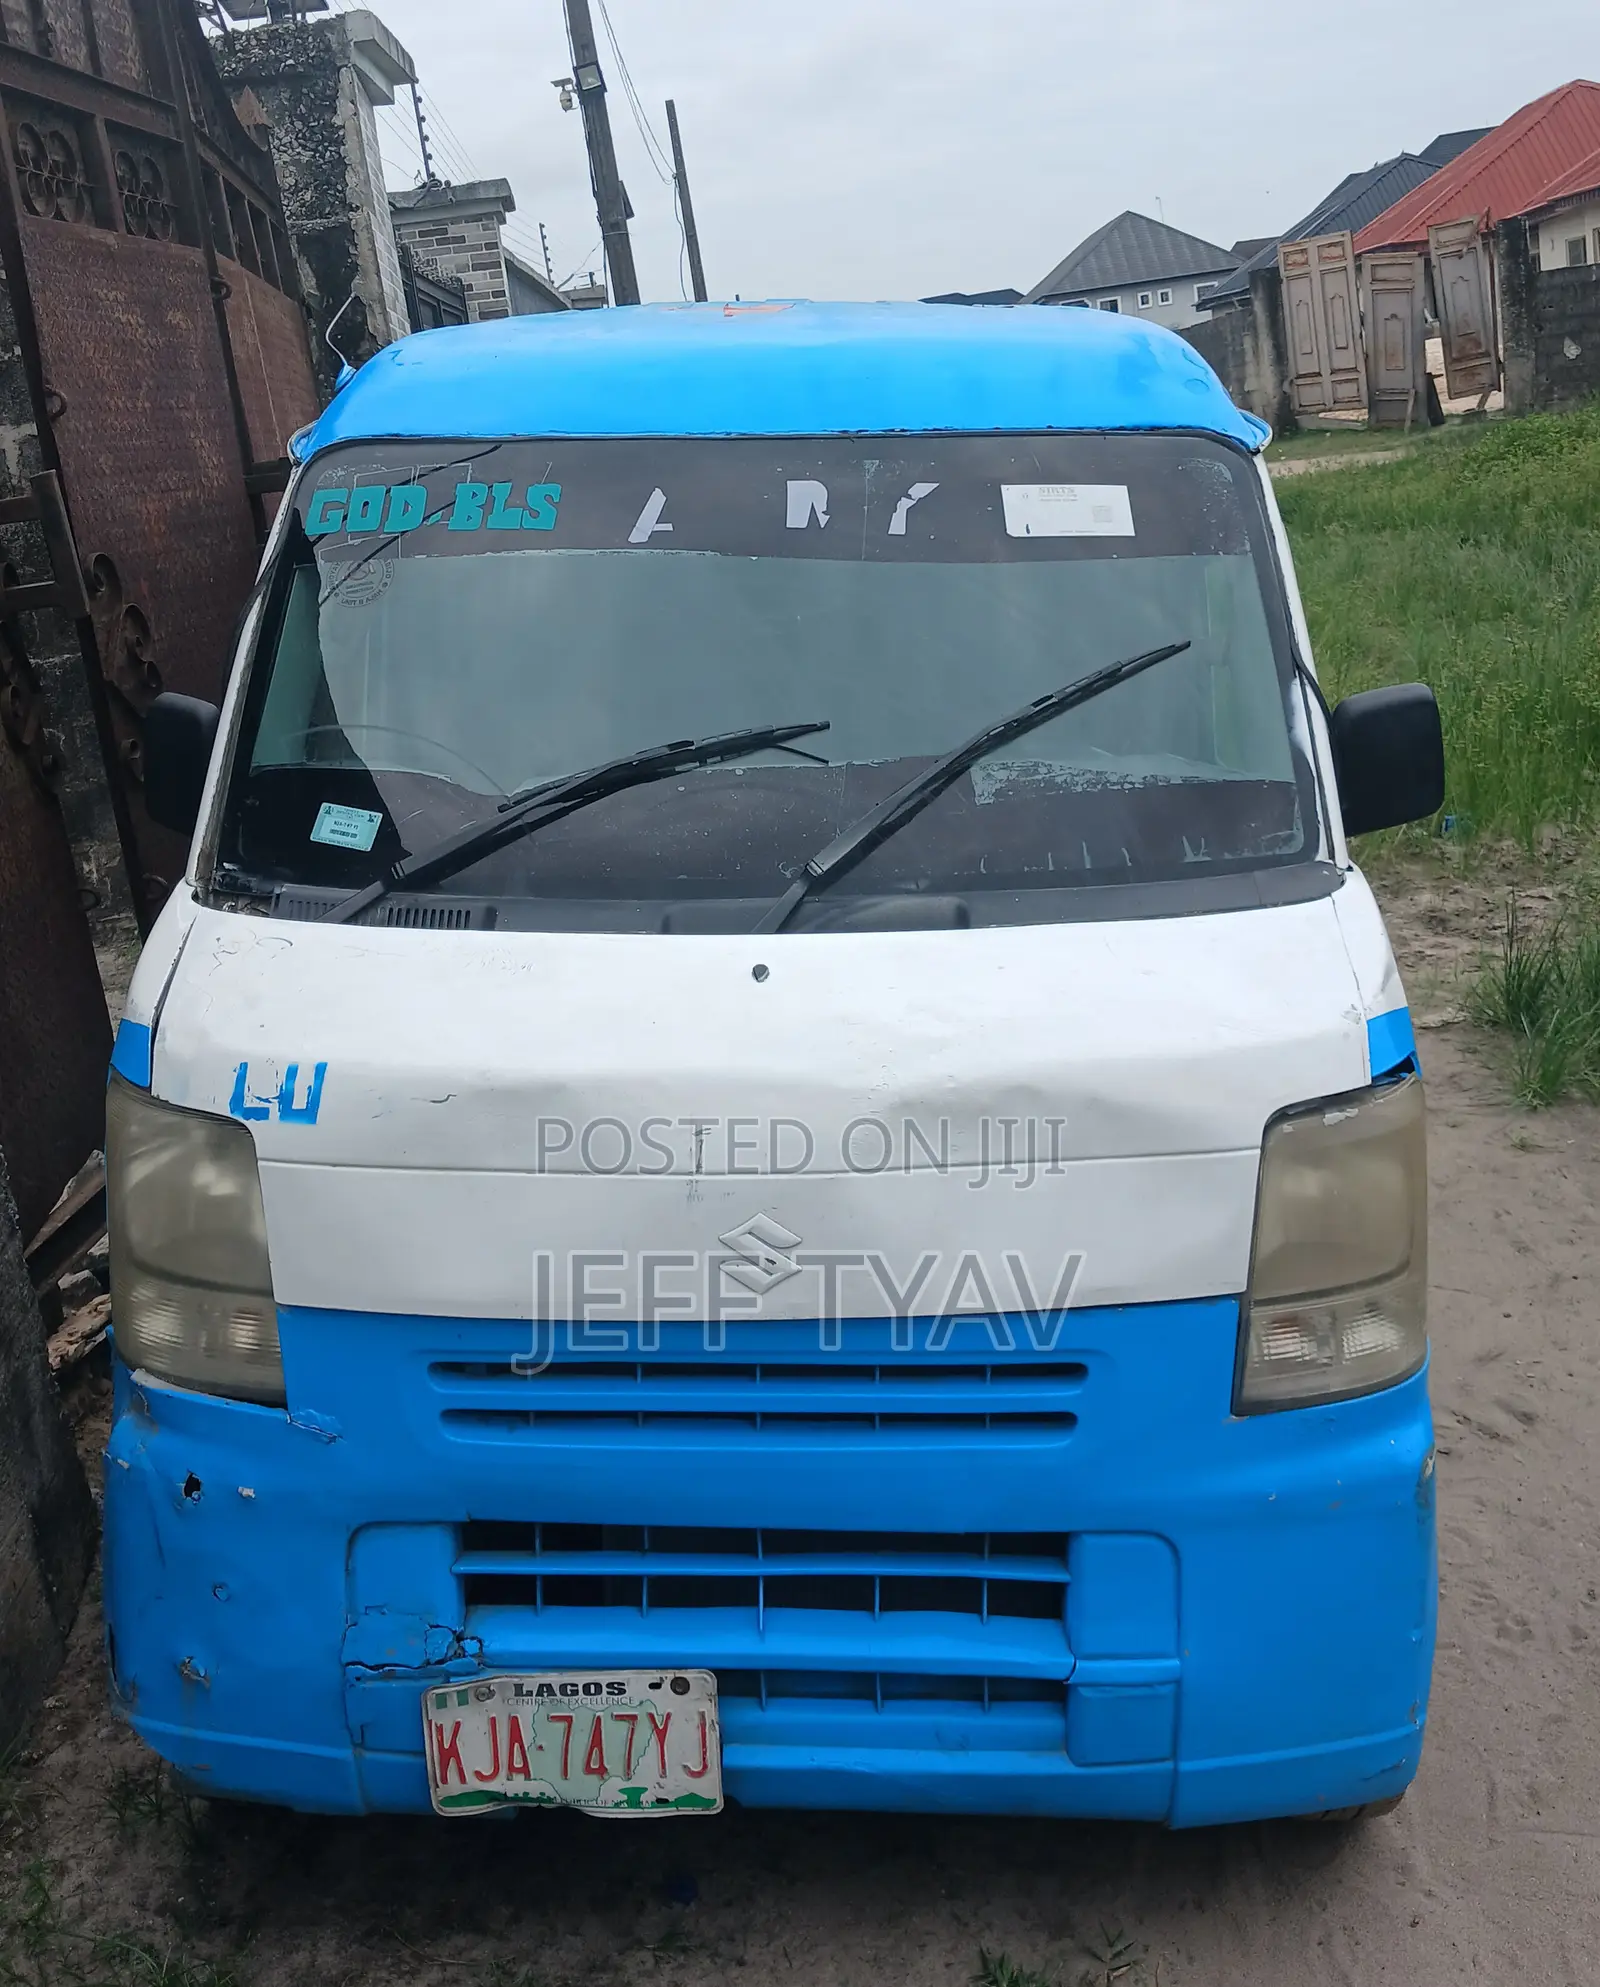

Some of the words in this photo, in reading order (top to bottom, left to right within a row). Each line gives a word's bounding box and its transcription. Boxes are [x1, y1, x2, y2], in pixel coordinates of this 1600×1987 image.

[305, 484, 428, 536] GOD
[448, 482, 562, 532] BLS
[513, 1681, 627, 1698] LAGOS
[567, 1695, 633, 1706] EXCELLENCE
